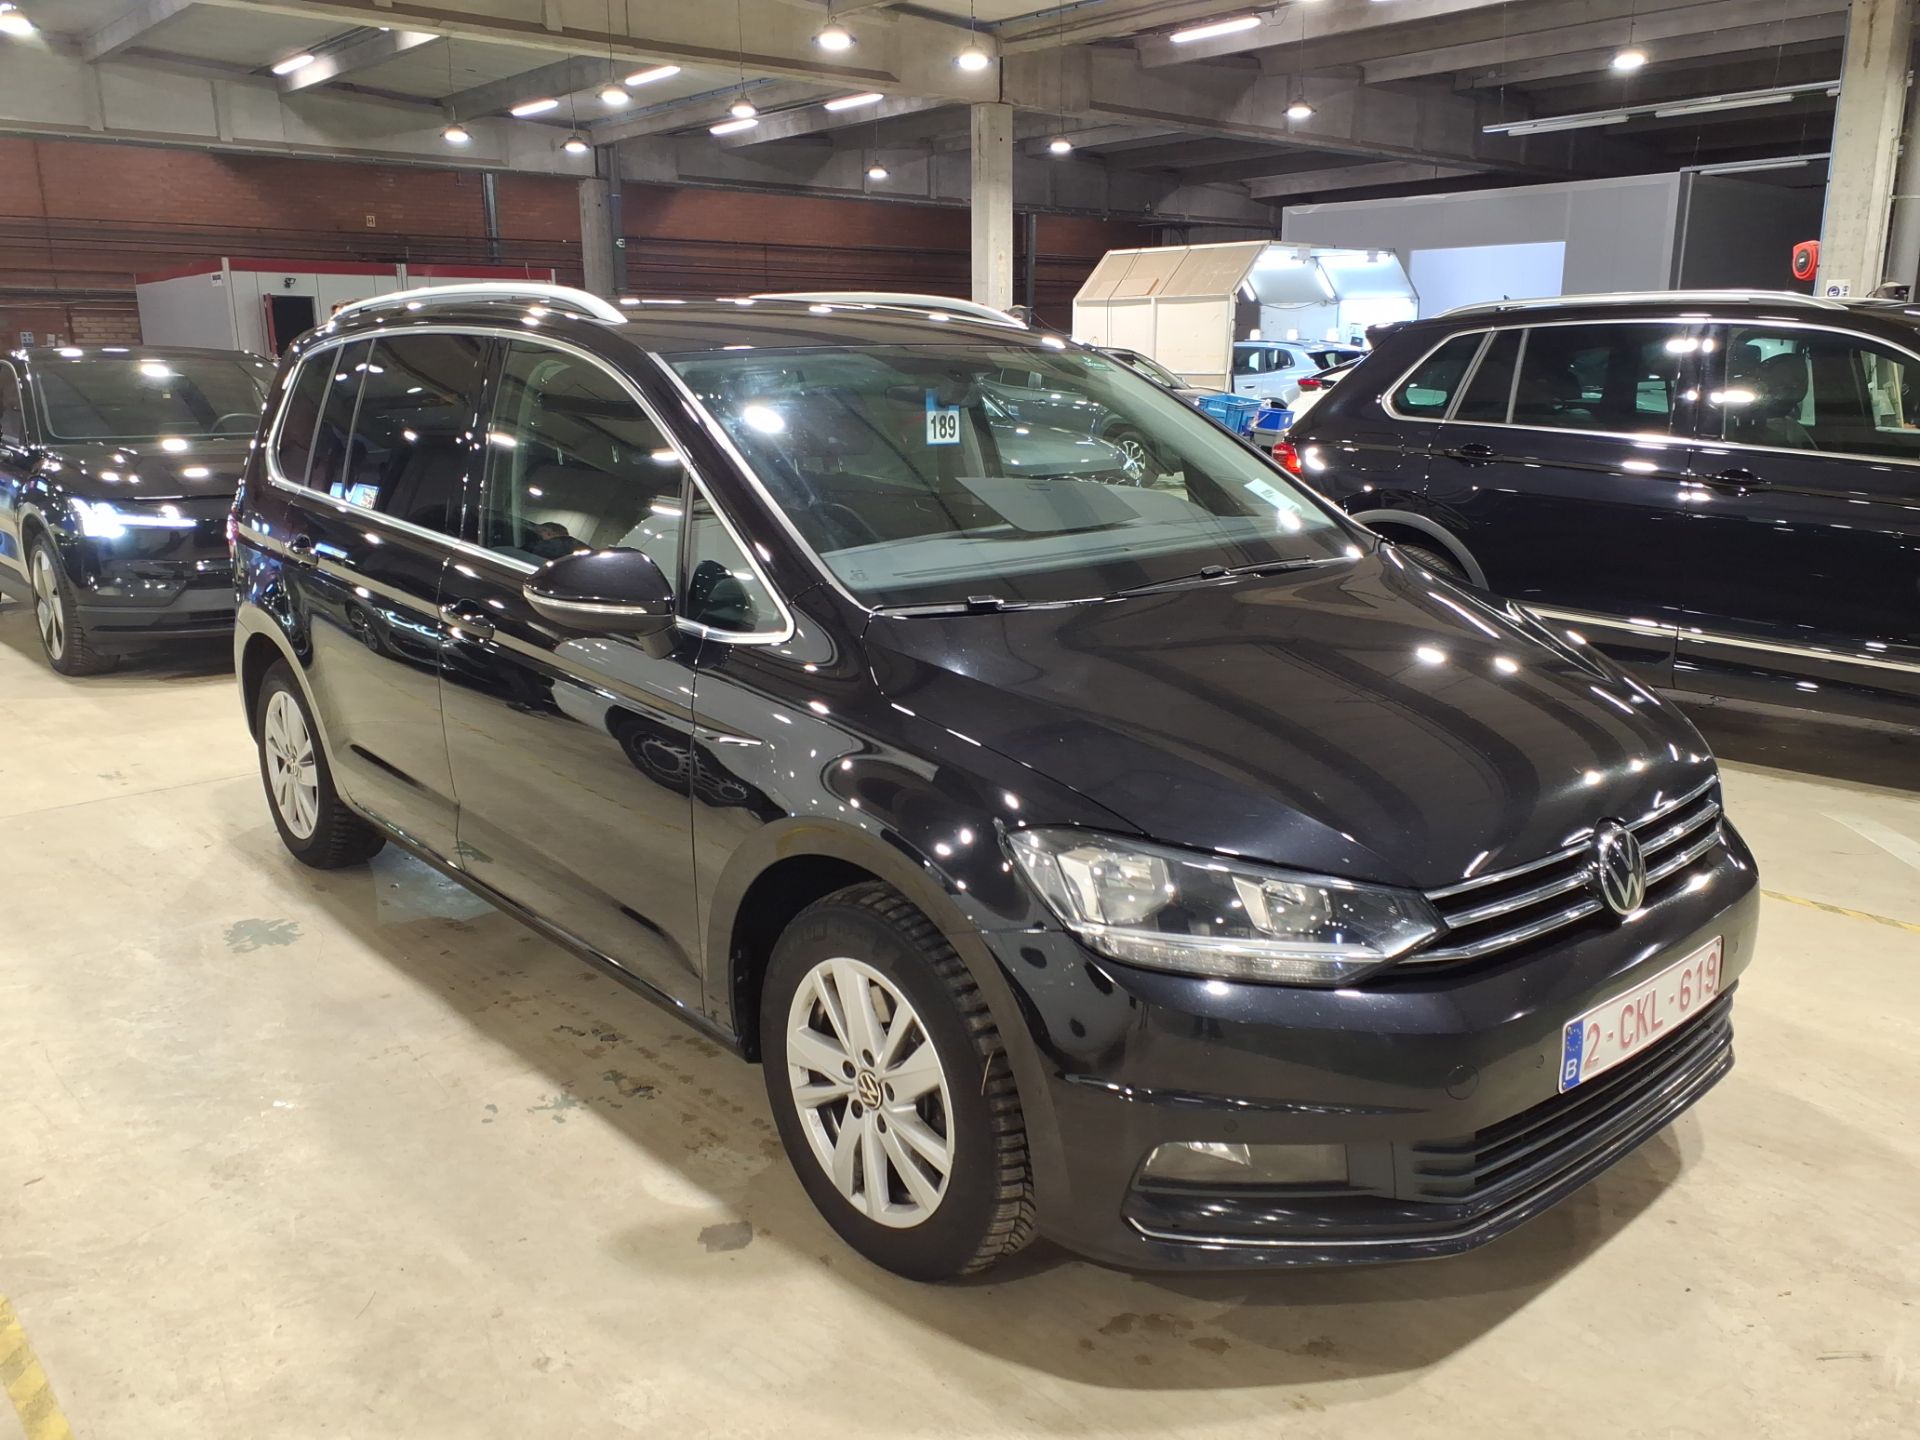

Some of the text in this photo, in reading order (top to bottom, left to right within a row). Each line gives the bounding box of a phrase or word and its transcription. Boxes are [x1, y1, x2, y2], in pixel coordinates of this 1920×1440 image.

[930, 414, 956, 439] 189
[1584, 951, 1717, 1069] 2-CKL-619
[1565, 1058, 1578, 1081] B
